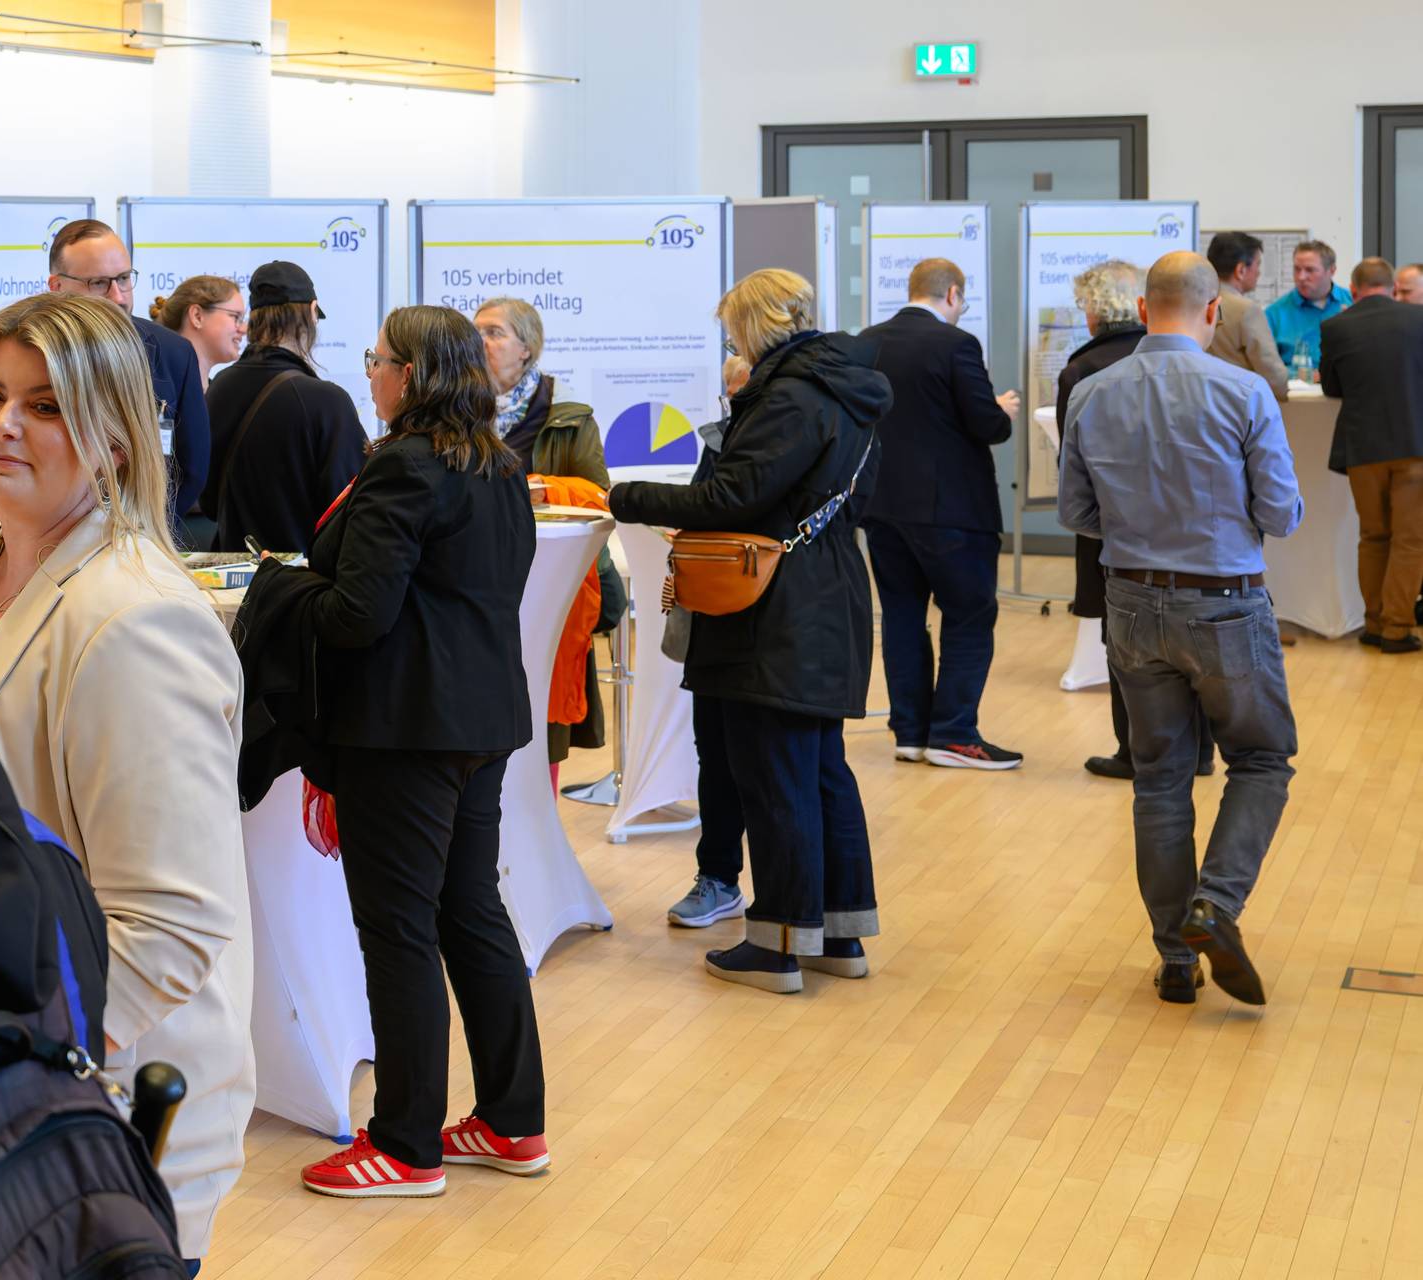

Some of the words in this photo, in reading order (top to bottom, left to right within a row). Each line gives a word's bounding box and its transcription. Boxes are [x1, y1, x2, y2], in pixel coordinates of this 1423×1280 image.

[660, 228, 695, 249] 105
[1159, 222, 1180, 239] 105
[331, 230, 359, 252] 105
[1040, 252, 1059, 265] 105
[149, 272, 175, 291] 105
[441, 269, 473, 286] 105
[476, 267, 564, 286] verbindet
[1039, 271, 1070, 285] Essen
[532, 292, 583, 315] Alltag
